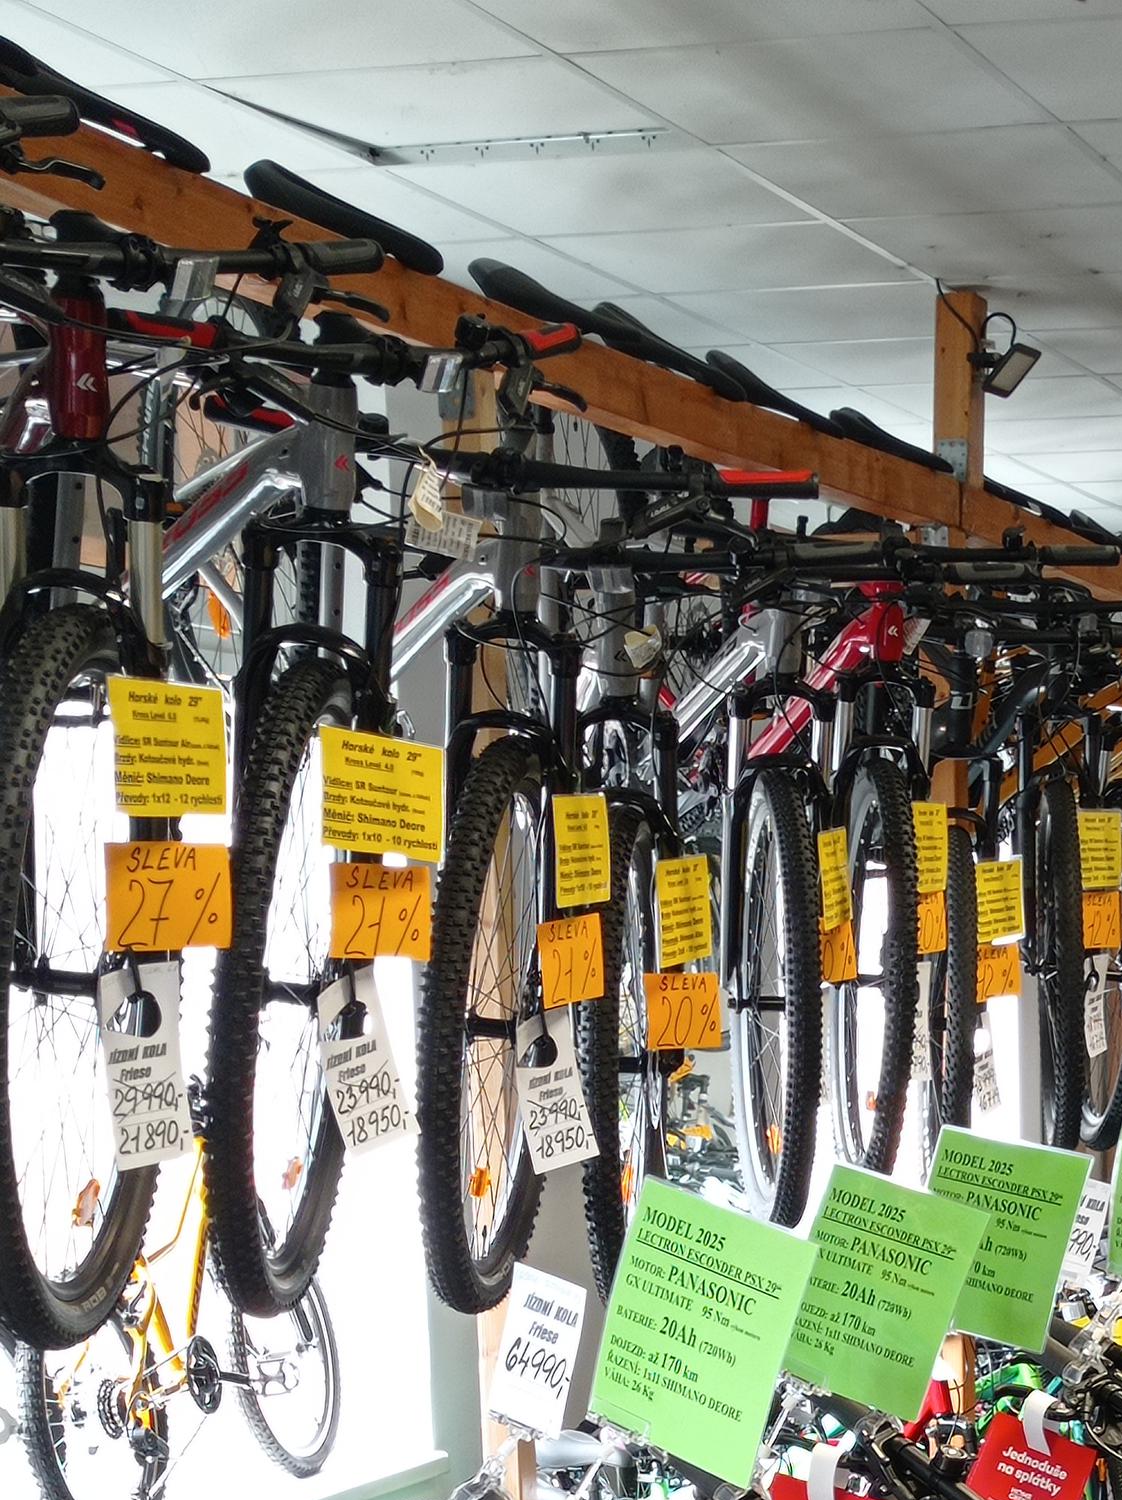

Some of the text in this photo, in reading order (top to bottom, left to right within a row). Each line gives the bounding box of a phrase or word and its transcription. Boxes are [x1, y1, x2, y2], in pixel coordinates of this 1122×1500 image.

[129, 691, 181, 706] Horské kolo
[342, 740, 422, 762] Horské kolo 29"
[147, 772, 210, 786] Shimano Deore
[355, 780, 366, 790] SR
[152, 794, 170, 804] 1x12
[180, 794, 188, 804] 12
[324, 808, 425, 832] Měnič: Shimano Deore
[322, 826, 401, 846] Převody: 1x10 10
[127, 847, 197, 874] SLEVA
[346, 866, 414, 892] SLEVA
[118, 872, 222, 946] 27 %
[344, 893, 422, 956] 21 %
[550, 924, 588, 942] SLEVA
[1107, 908, 1117, 944] %
[977, 948, 1008, 960] SLEVA
[552, 938, 597, 1004] 21 %
[659, 976, 707, 992] SLEVA
[656, 993, 717, 1047] 20 %
[142, 1042, 168, 1060] KOLA
[356, 1040, 377, 1060] KOLA
[120, 1066, 152, 1082] Friese
[338, 1064, 366, 1081] Friese
[942, 1149, 1014, 1176] MODEL 2025
[938, 1165, 1046, 1200] LECTRON ESCONDER PSX
[830, 1188, 906, 1222] MODEL 2025
[966, 1191, 1042, 1222] PANASONIC
[643, 1207, 726, 1252] MODEL 2025
[823, 1206, 940, 1252] LECTRON ESCONDER PSX
[637, 1228, 764, 1288] LECTRON ESCONDER PSX
[816, 1230, 933, 1276] MOTOR: PANASONIC
[994, 1245, 1027, 1262] (720Wh)
[826, 1251, 908, 1286] ULTIMATE 95 Nm
[982, 1264, 996, 1278] km
[630, 1256, 757, 1316] MOTOR: PANASONIC
[1005, 1287, 1033, 1303] DEORE
[524, 1293, 578, 1328] JÍZDNÍ KOLA
[625, 1274, 730, 1328] GX ULTIMATE 95 Nm
[841, 1280, 912, 1320] 20Ah (720Wh)
[529, 1321, 559, 1344] Friese
[616, 1305, 737, 1367] BATERIE: 20Ah (720Wh)
[830, 1310, 876, 1336] až 170 km
[610, 1335, 699, 1383] DOJEZD: až 170 km
[823, 1343, 835, 1356] Kg
[826, 1327, 916, 1368] 1x11 SHIMANO DEORE
[607, 1352, 743, 1422] ŘAZENÍ: 1x11 SHIMANO DEORE
[631, 1380, 642, 1392] 26
[642, 1385, 654, 1401] Kg
[1002, 1446, 1067, 1480] Jednoduše
[997, 1462, 1061, 1497] na splátky
